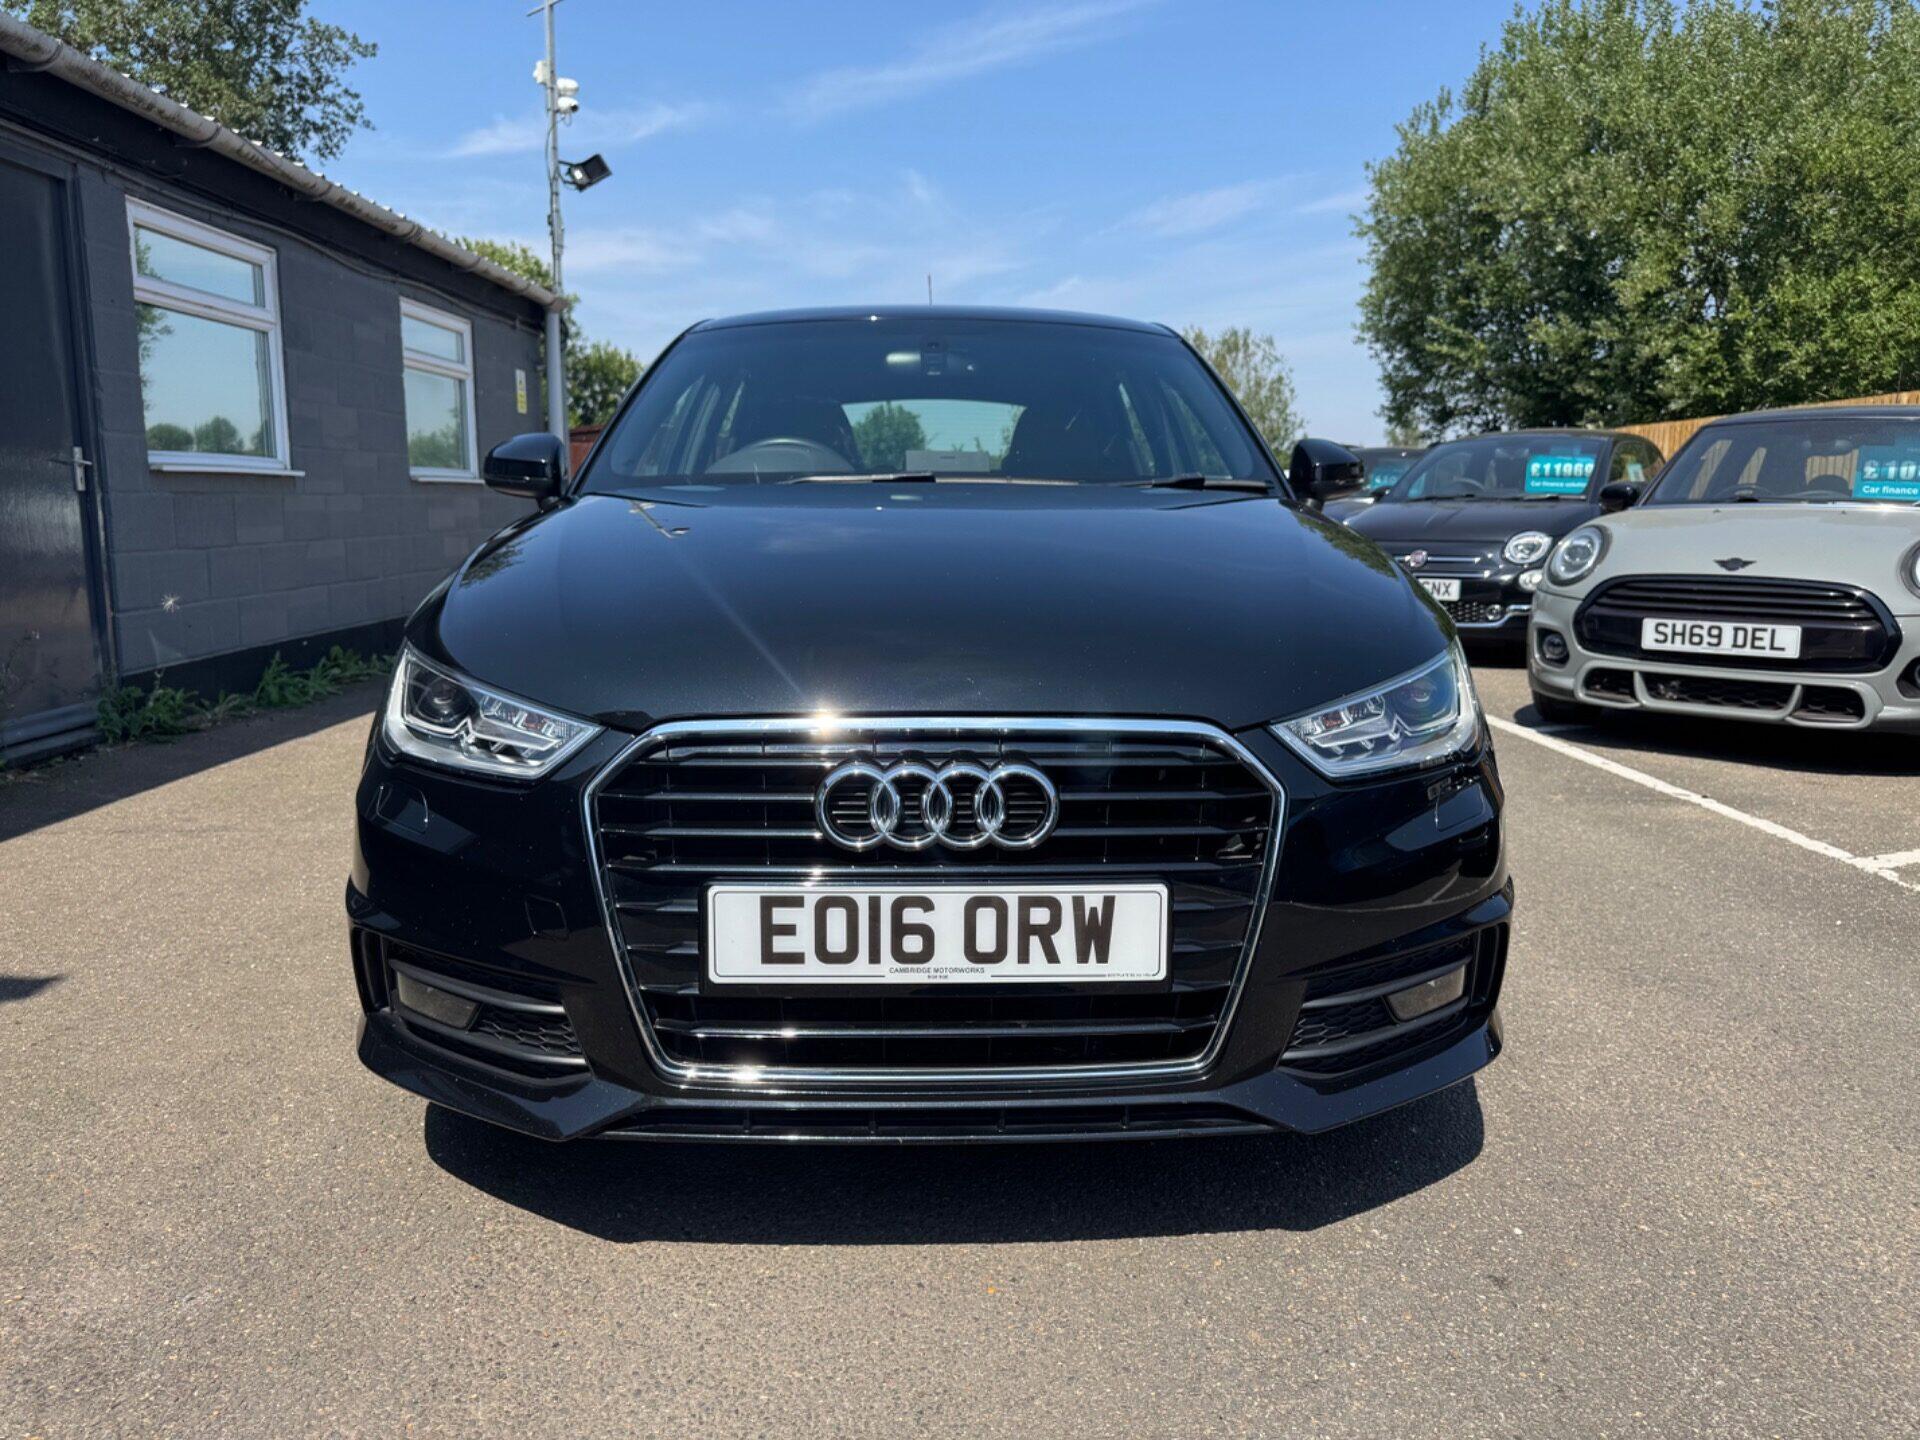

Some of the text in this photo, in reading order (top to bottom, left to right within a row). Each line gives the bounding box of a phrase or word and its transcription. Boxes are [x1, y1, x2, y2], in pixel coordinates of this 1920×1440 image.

[1863, 460, 1920, 480] £10
[1862, 485, 1919, 495] Car finance
[1654, 622, 1786, 651] SH69 DEL
[759, 895, 1116, 965] EO16 ORW
